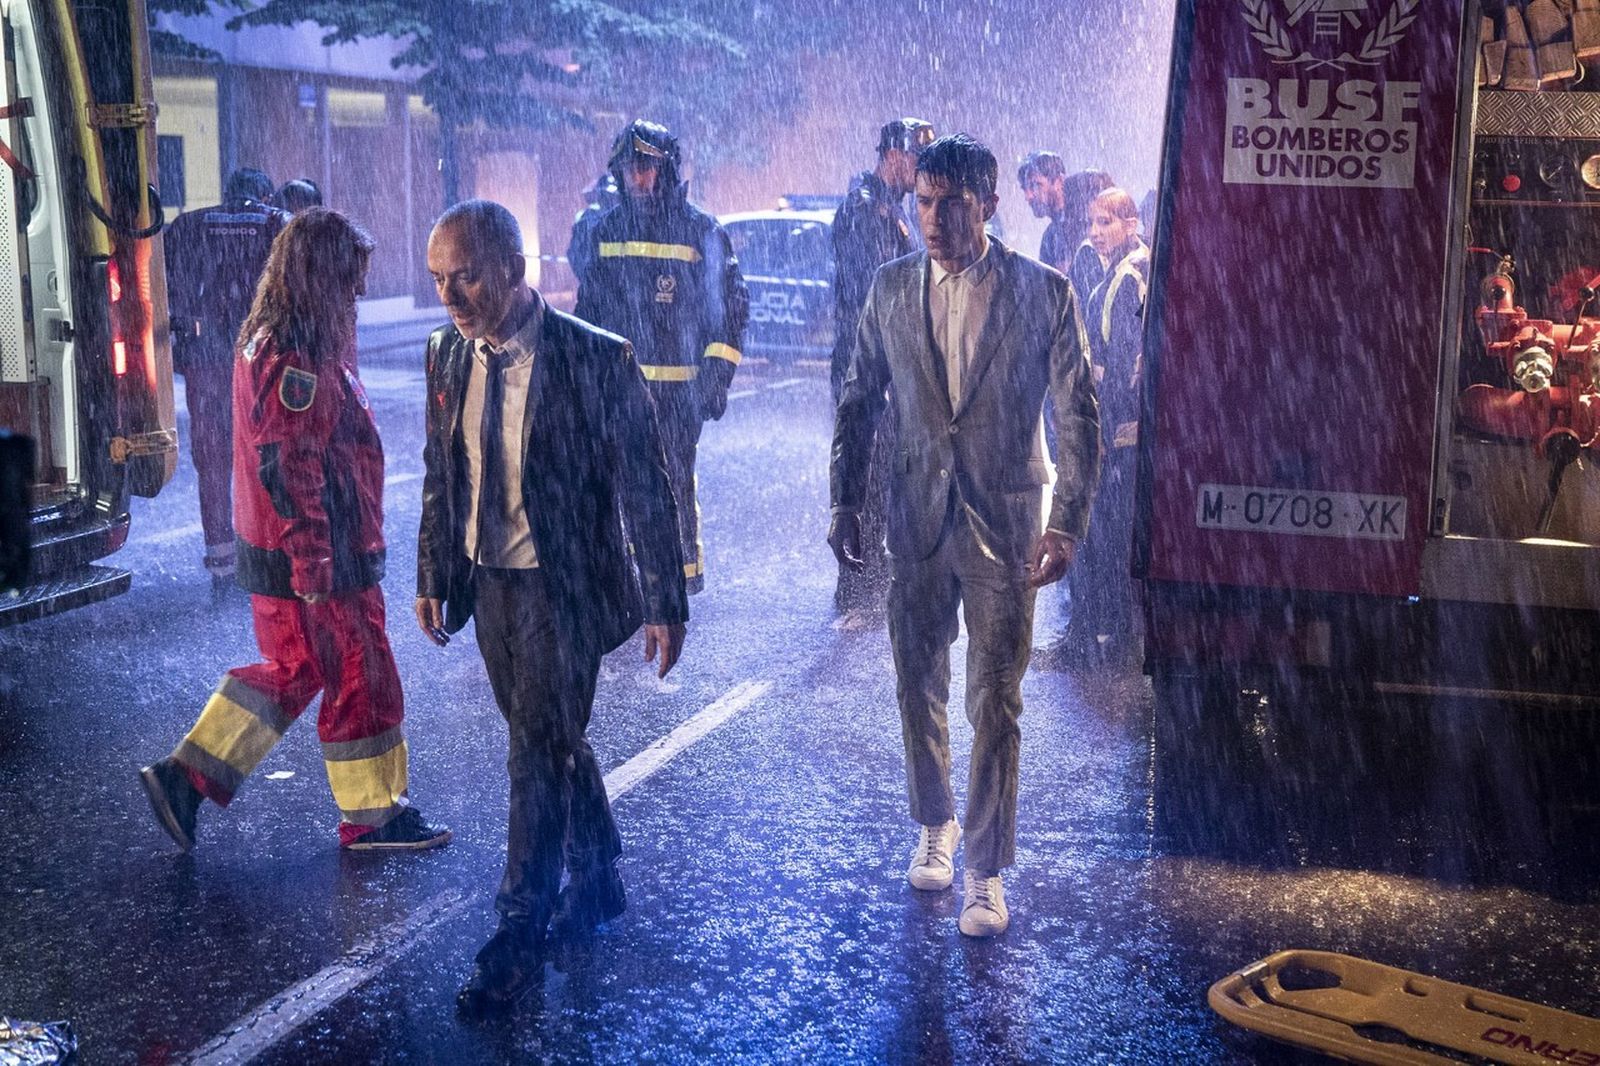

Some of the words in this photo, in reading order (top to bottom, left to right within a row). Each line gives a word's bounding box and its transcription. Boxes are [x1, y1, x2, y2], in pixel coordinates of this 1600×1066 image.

[1227, 78, 1421, 121] BUSF
[1231, 125, 1410, 154] BOMBEROS
[1255, 153, 1382, 180] UNIDOS
